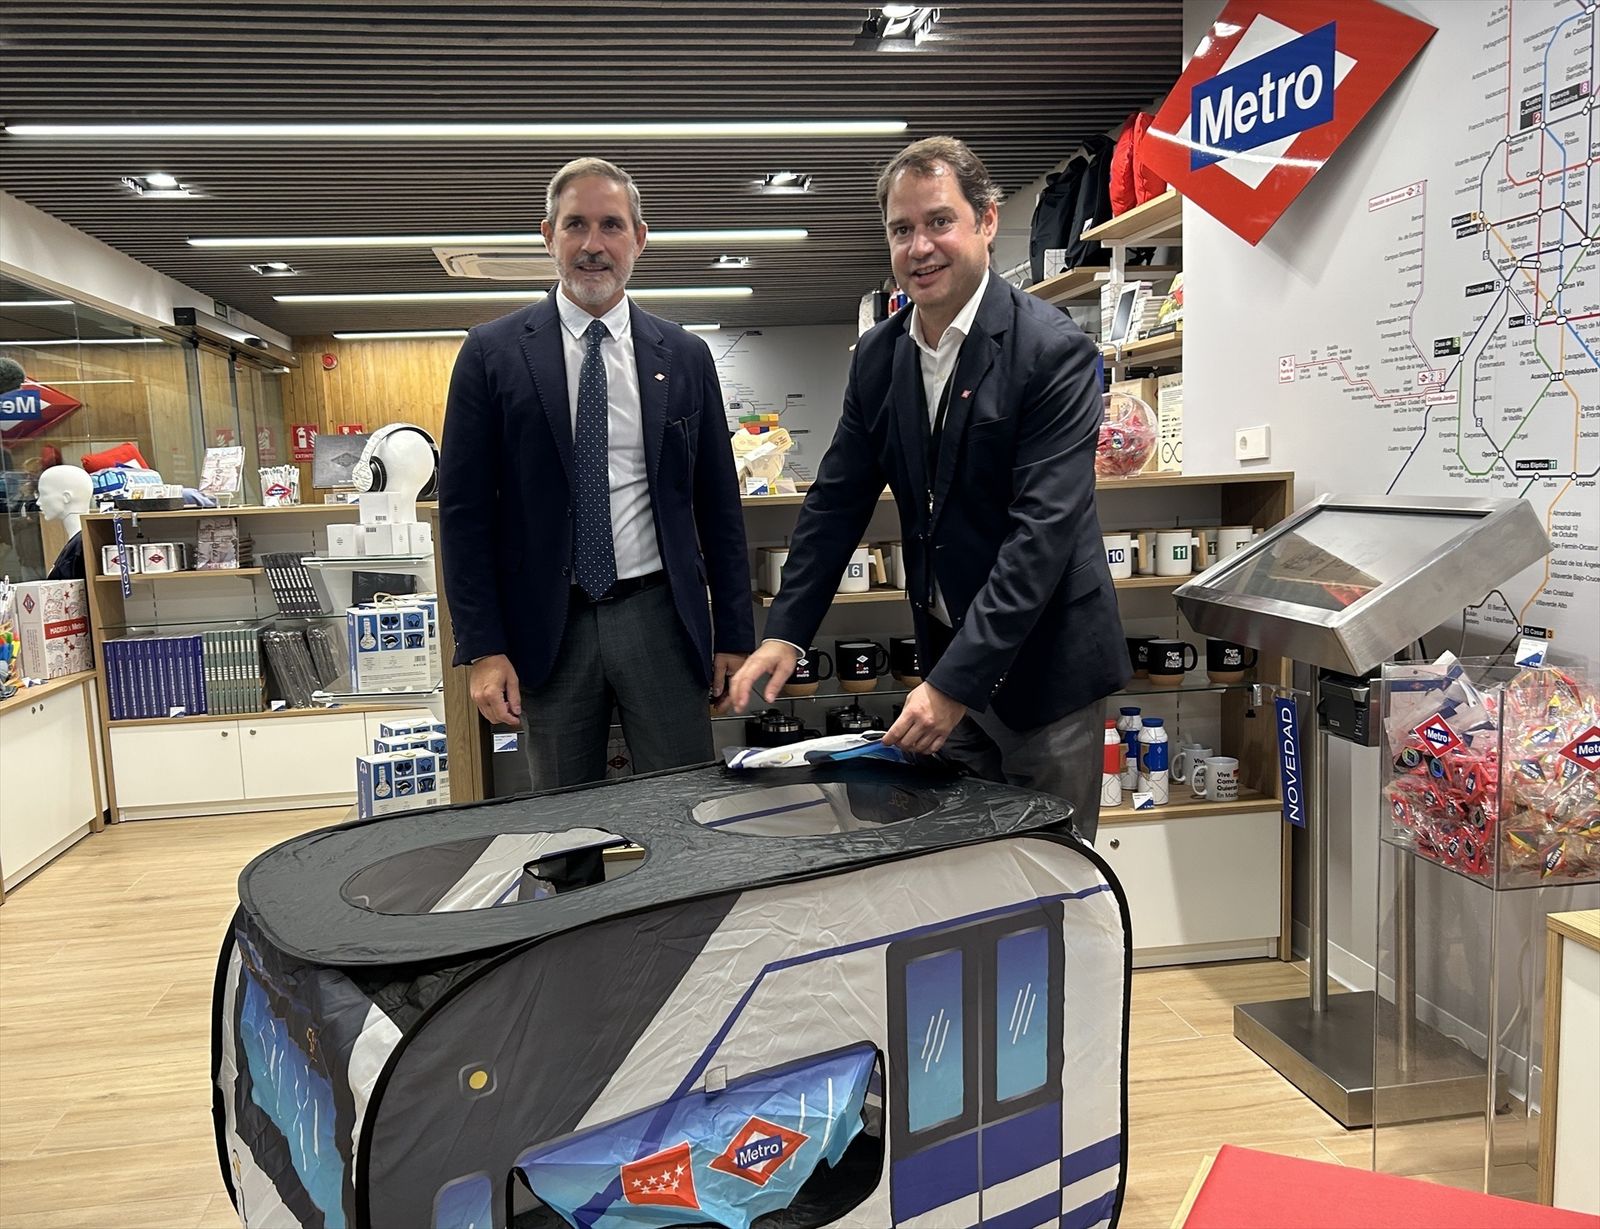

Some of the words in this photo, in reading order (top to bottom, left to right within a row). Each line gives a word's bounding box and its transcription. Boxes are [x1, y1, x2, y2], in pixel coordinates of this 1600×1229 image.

[1582, 83, 1588, 93] 8
[1200, 64, 1323, 147] Metro
[1534, 113, 1541, 123] 2
[1110, 551, 1124, 563] 10
[1174, 547, 1187, 559] 11
[852, 564, 860, 577] 6
[1548, 630, 1553, 638] 3
[1428, 729, 1448, 743] Metro
[1282, 707, 1300, 821] NOVEDAD
[1547, 850, 1562, 868] Metro
[740, 1144, 780, 1166] Metro
